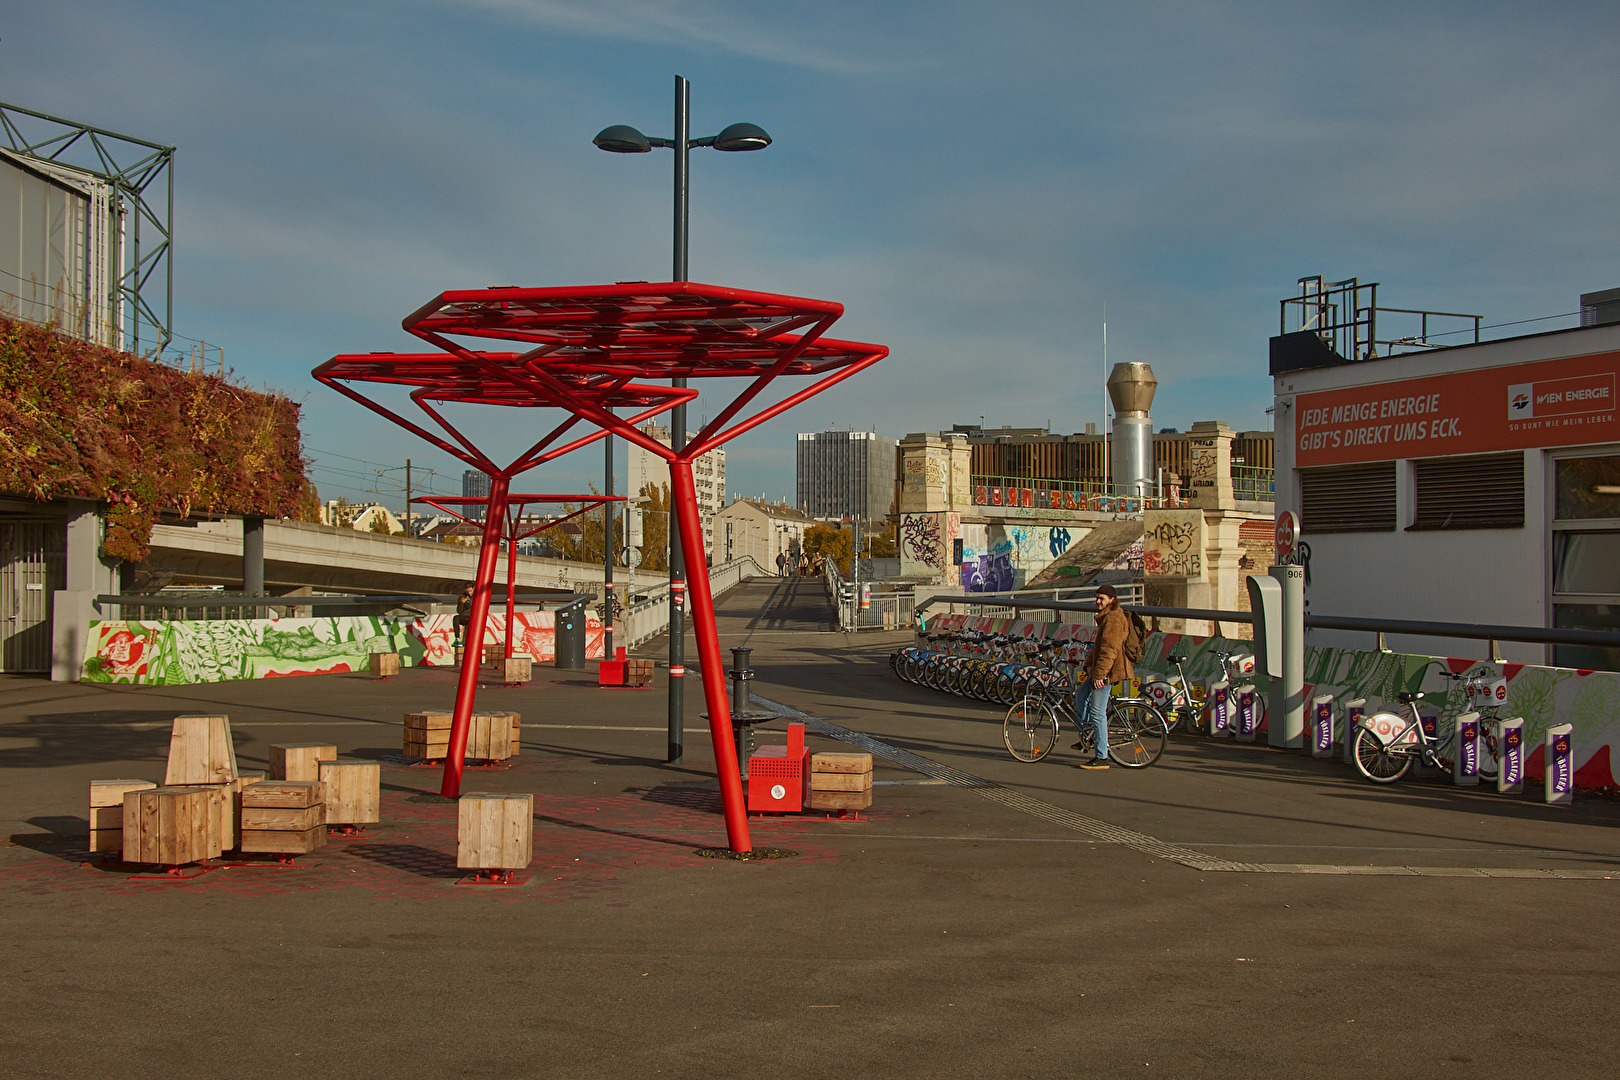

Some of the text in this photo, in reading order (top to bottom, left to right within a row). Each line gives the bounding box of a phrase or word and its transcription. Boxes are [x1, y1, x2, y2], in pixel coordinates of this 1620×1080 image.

[1565, 386, 1610, 402] ENERGIE
[1300, 394, 1440, 430] JEDE MENGE ENERGIE
[1522, 421, 1542, 430] BUNT
[1545, 419, 1560, 428] WIE
[1562, 417, 1583, 426] MEIN
[1586, 414, 1616, 424] LEBEN.
[1300, 417, 1463, 451] GIBT'S DIREKT UMS ECK.
